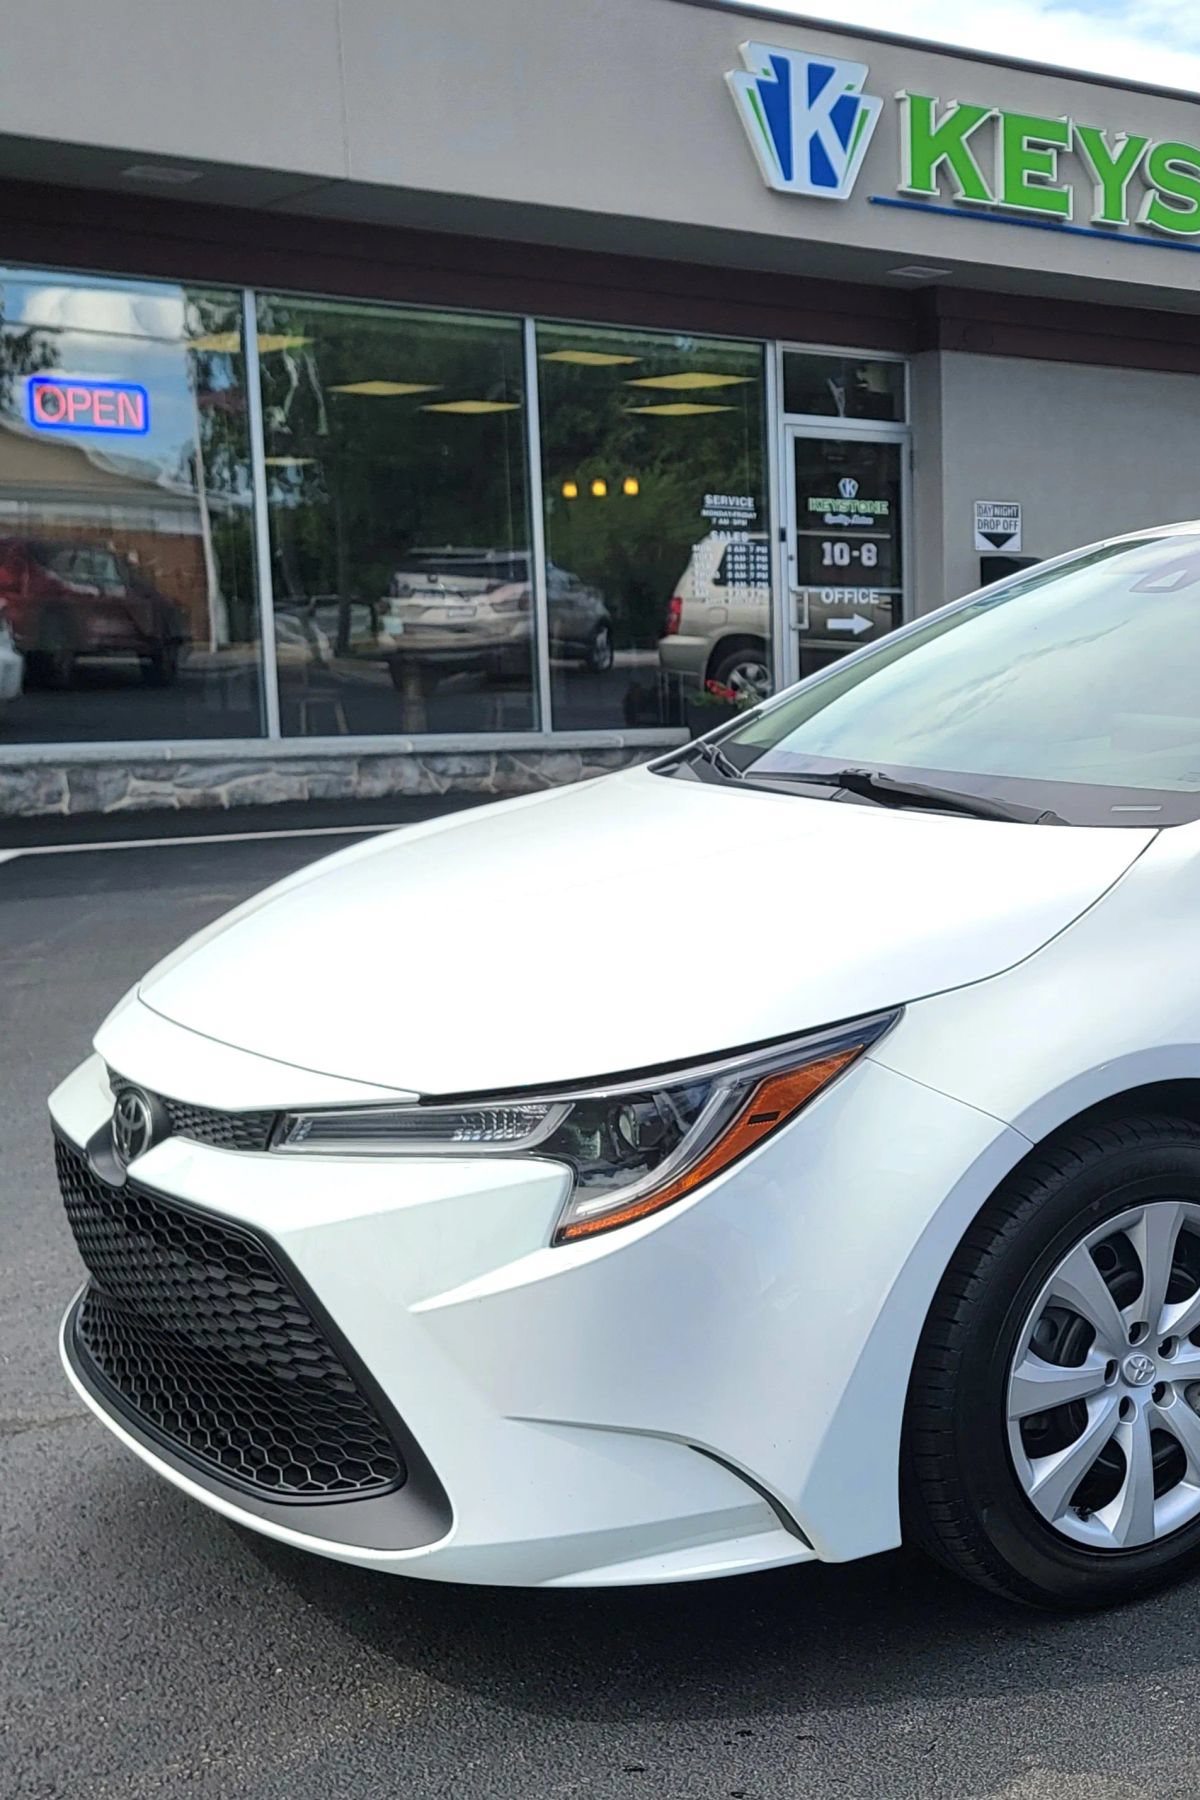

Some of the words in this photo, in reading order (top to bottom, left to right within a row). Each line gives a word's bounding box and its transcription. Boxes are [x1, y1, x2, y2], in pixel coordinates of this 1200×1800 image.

[35, 383, 145, 428] OPEN
[704, 494, 755, 507] SERVICE
[808, 497, 889, 515] KEYSTONE
[977, 519, 1001, 530] DROP
[1002, 520, 1019, 531] OFF
[710, 530, 749, 542] SALES
[821, 587, 880, 604] OFFICE
